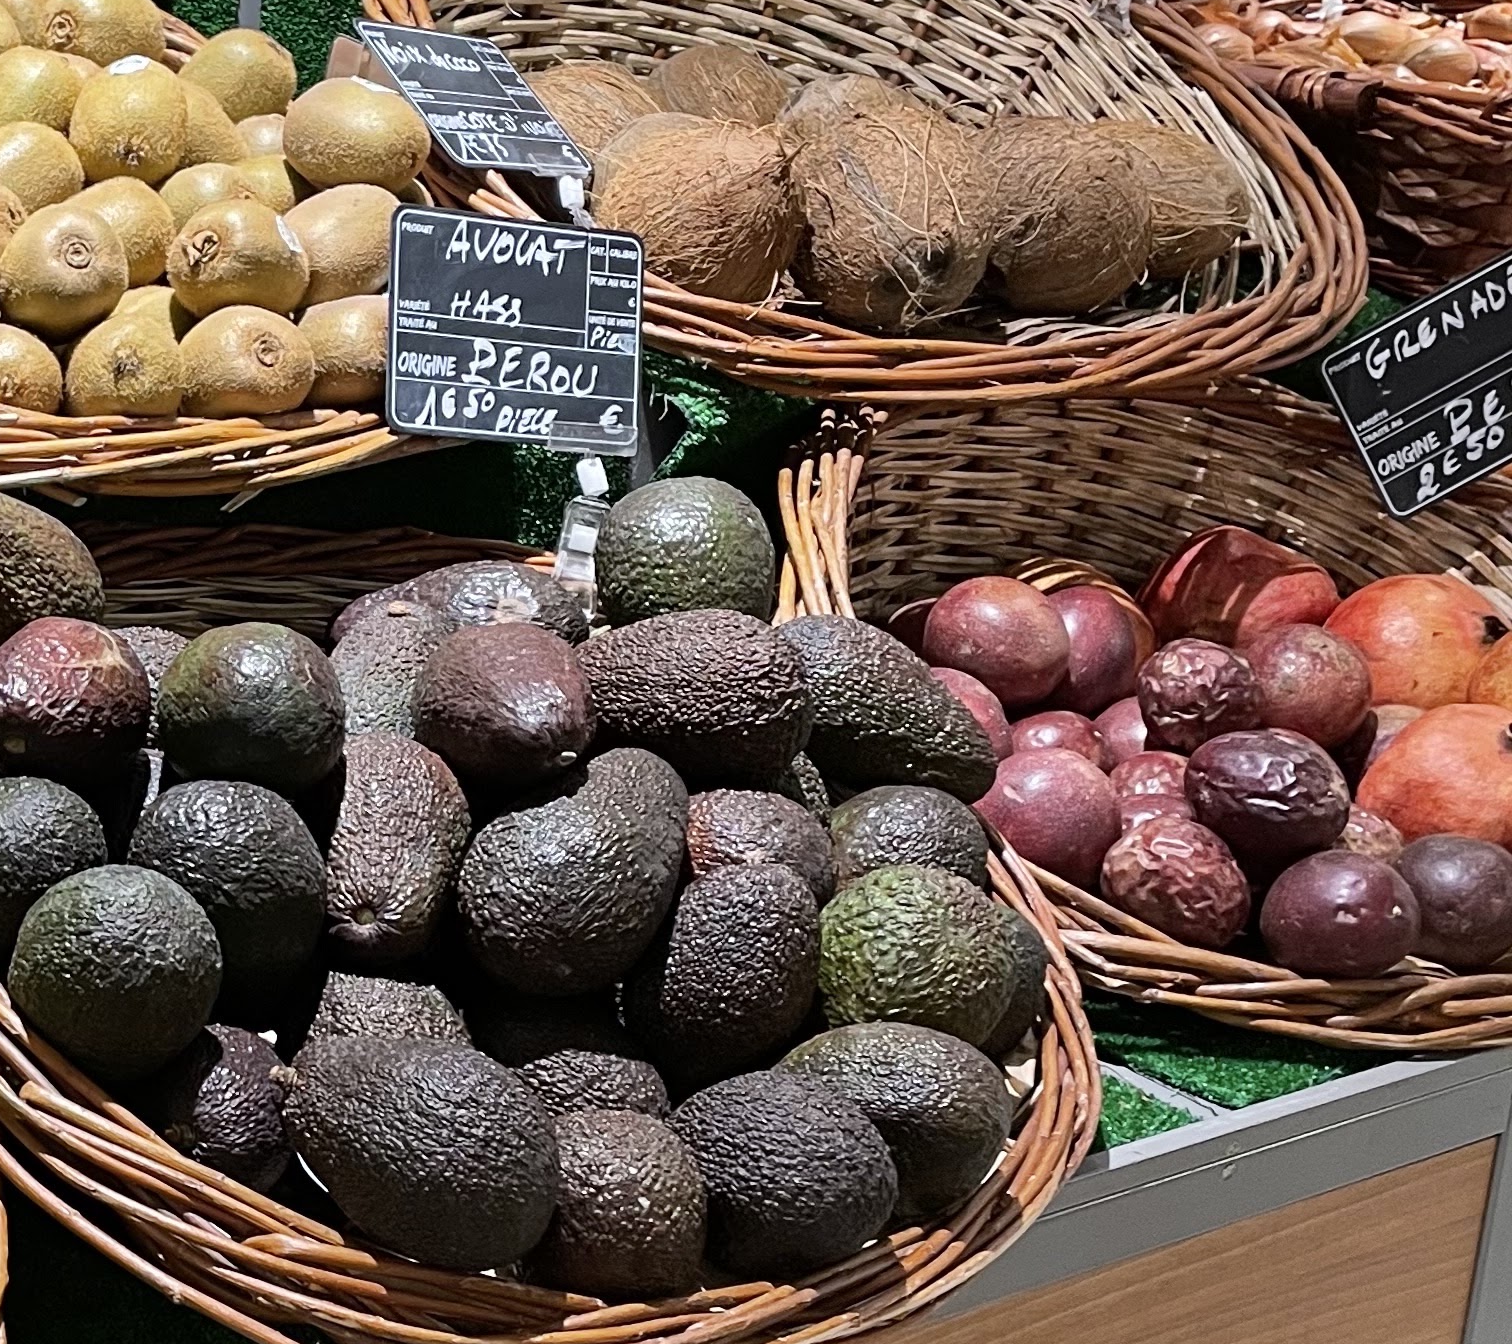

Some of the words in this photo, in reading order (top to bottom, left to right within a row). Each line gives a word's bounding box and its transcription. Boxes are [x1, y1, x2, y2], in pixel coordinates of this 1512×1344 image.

[445, 219, 587, 277] AVOCAT
[398, 351, 457, 377] ORIGINE
[461, 338, 600, 398] PEROU
[1377, 430, 1441, 476] ORIGINE
